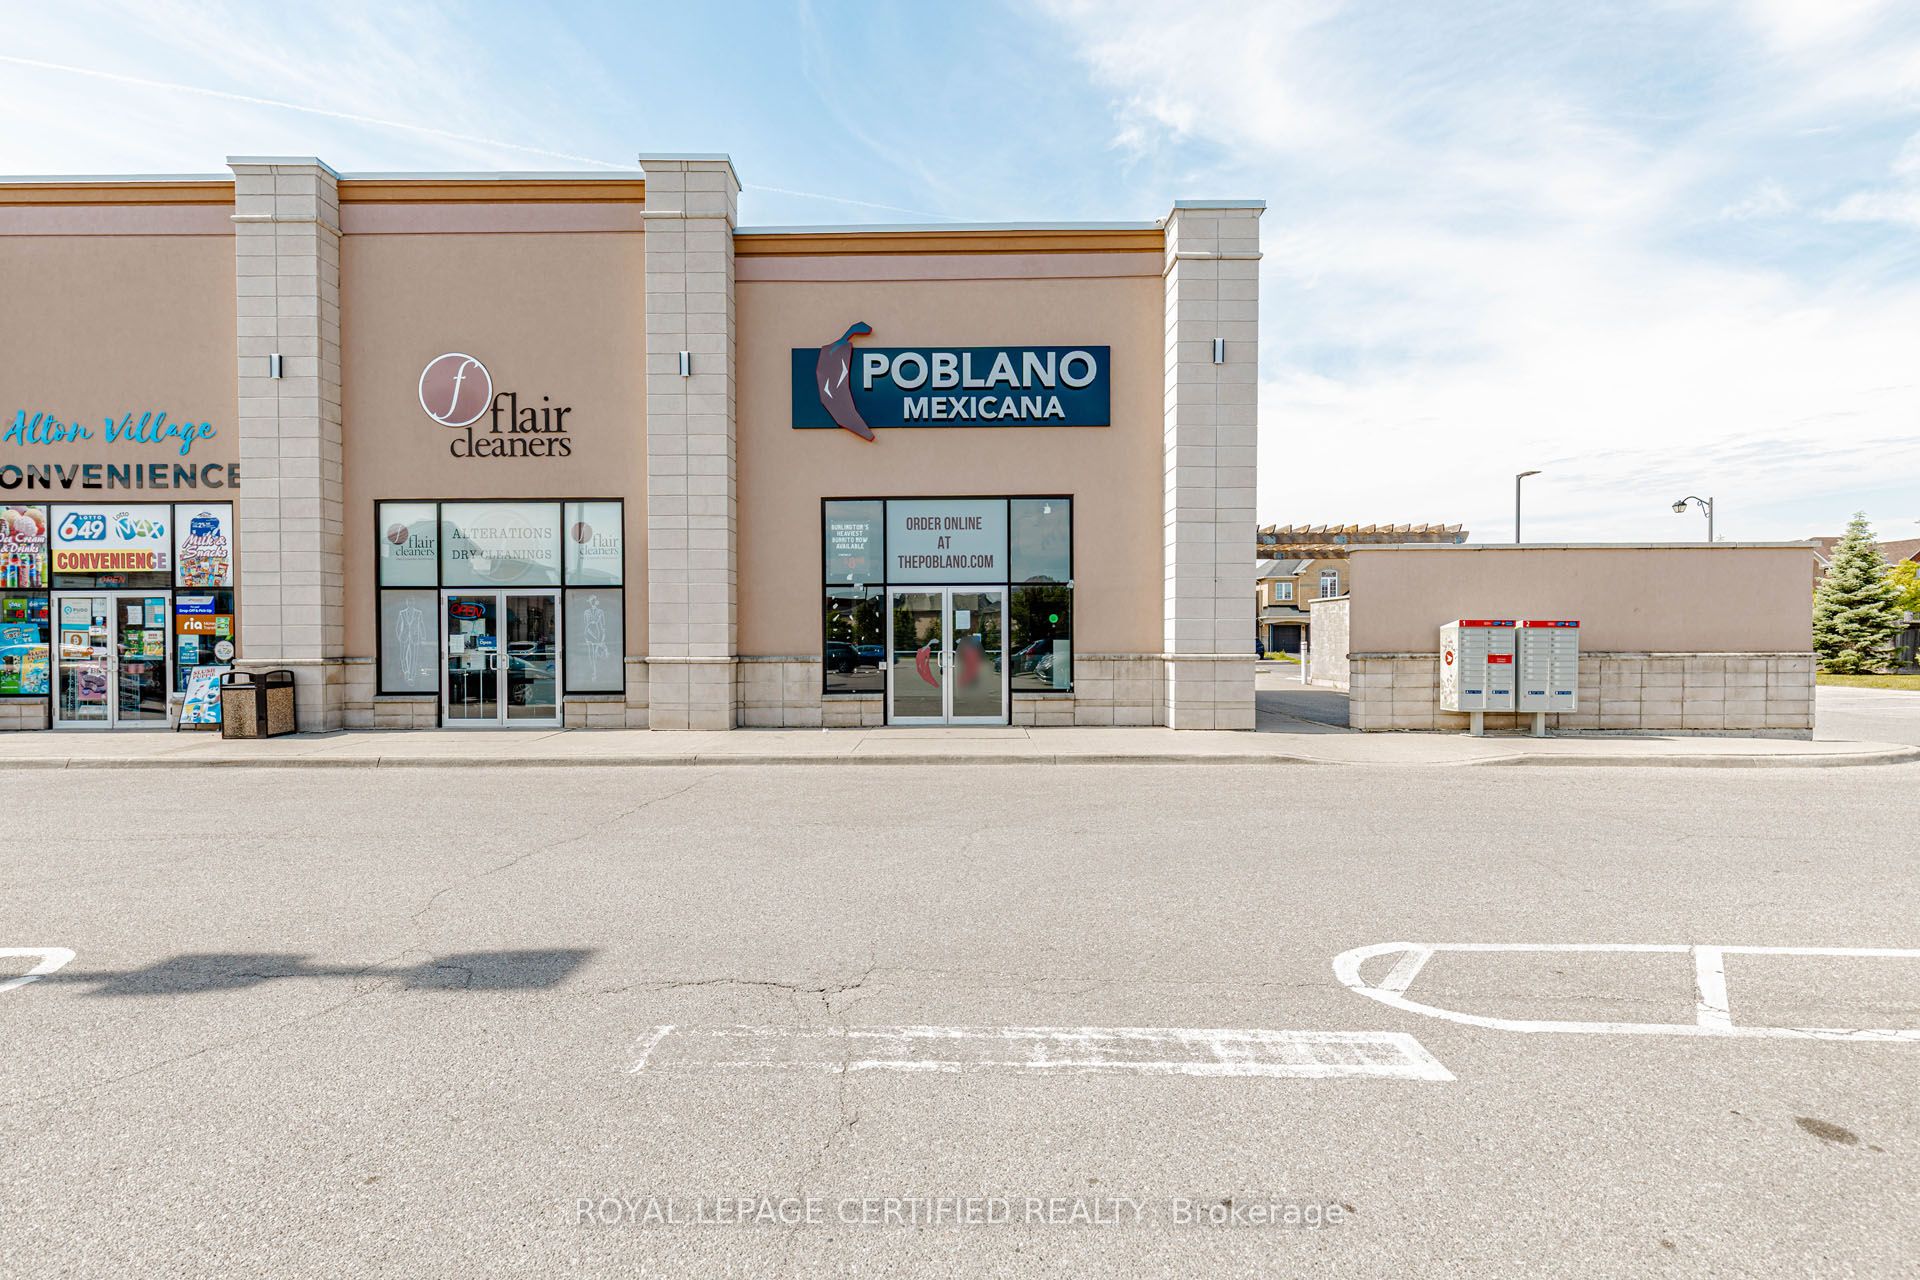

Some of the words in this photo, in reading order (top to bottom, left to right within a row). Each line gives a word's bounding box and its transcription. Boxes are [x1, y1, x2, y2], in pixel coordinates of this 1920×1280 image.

[863, 351, 1098, 390] POBLANO
[489, 391, 572, 434] flair
[903, 396, 1066, 420] MEXICANA
[3, 409, 94, 446] Alton
[104, 410, 217, 456] Village
[450, 427, 572, 458] cleaners
[113, 512, 129, 521] LOTTO
[906, 516, 942, 530] ORDER
[944, 516, 982, 530] ONLINE
[115, 518, 165, 540] MAX
[452, 527, 552, 539] ALTERATIONS
[182, 532, 214, 549] Milk
[216, 536, 226, 546] &
[408, 534, 436, 548] flair
[593, 533, 619, 547] flair
[937, 536, 951, 549] AT
[10, 543, 39, 553] Drinks
[181, 546, 227, 561] Snacks
[395, 546, 435, 556] cleaners
[452, 549, 477, 560] DRY
[480, 549, 552, 560] CLEANINGS
[579, 545, 619, 555] cleaners
[57, 552, 166, 570] CONVENIENCE
[897, 555, 994, 569] THEPOBLANO.COM
[450, 603, 482, 617] OPEN
[184, 617, 202, 630] ria
